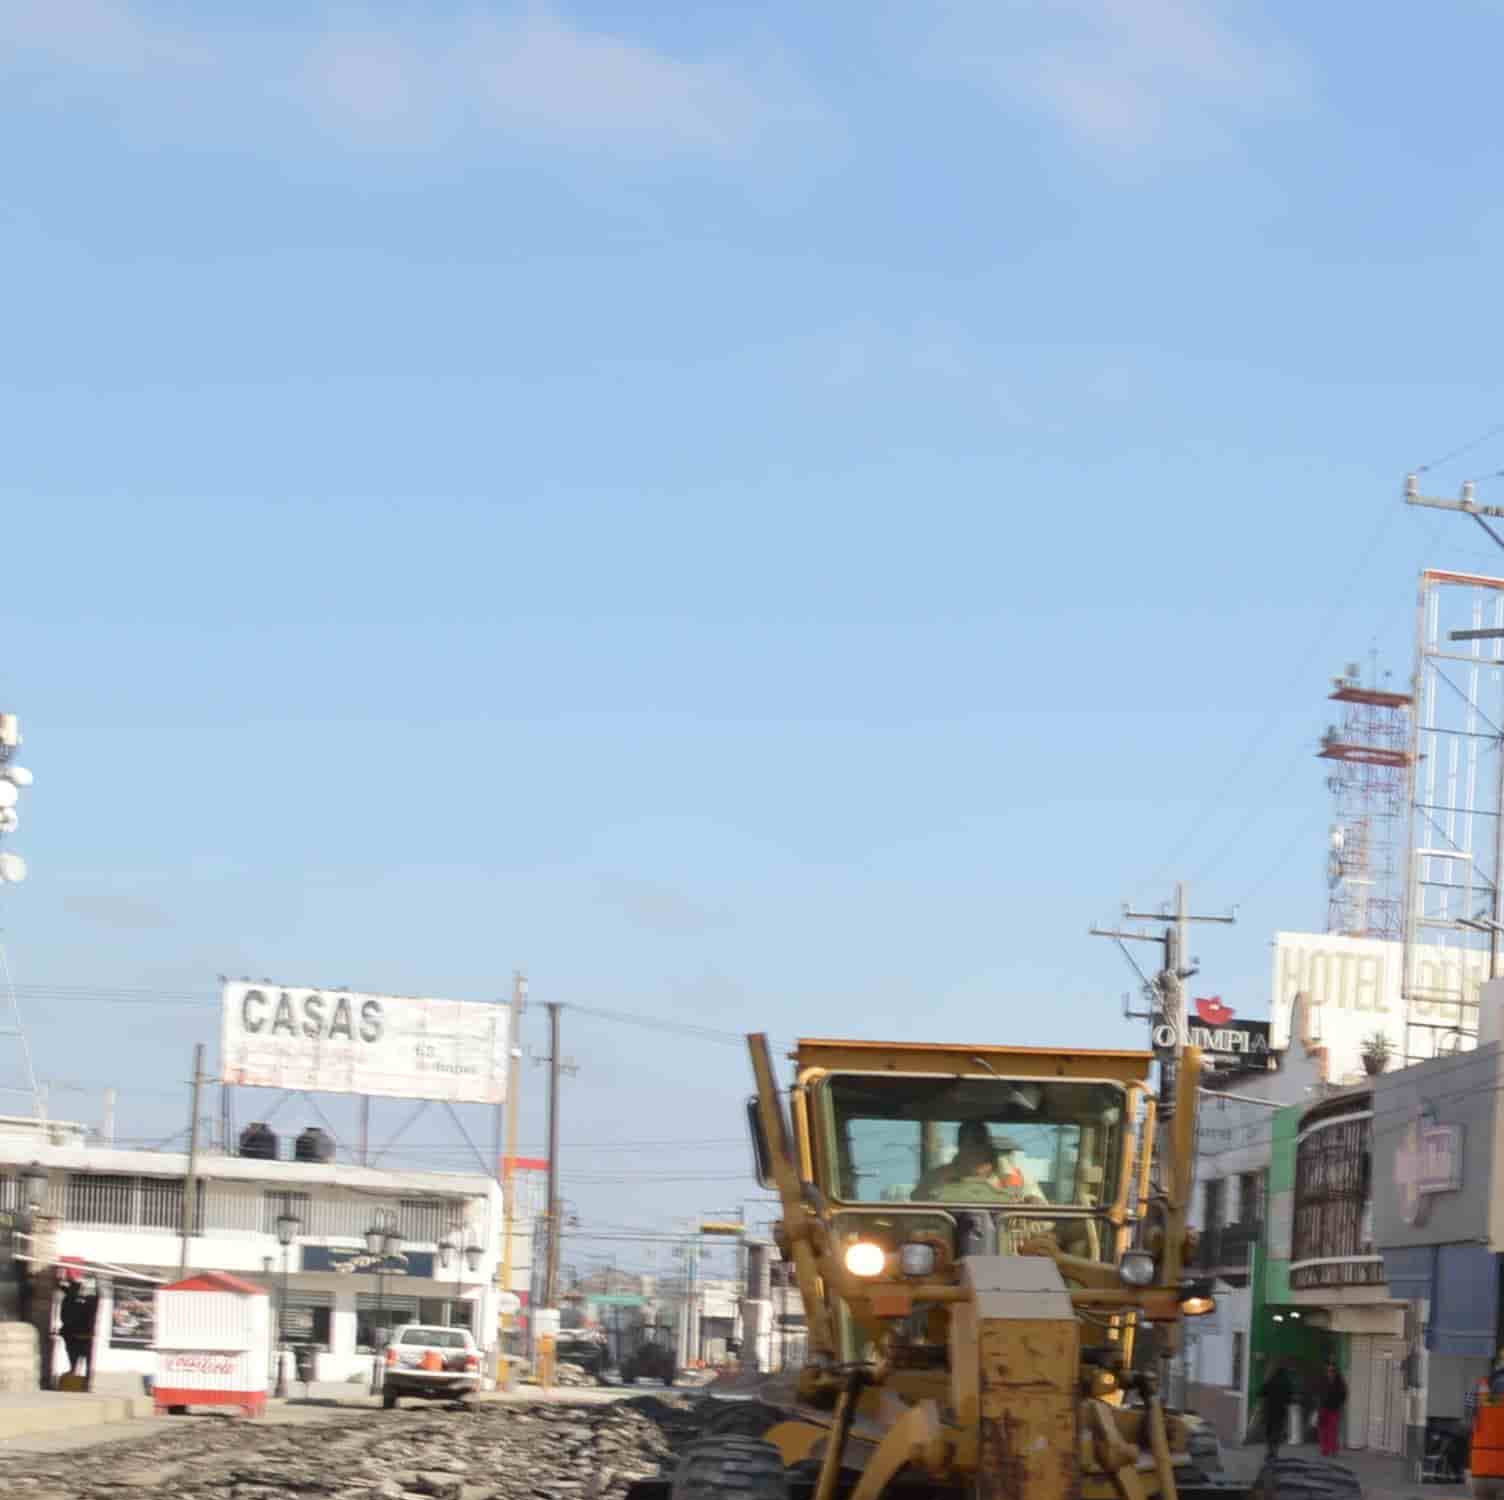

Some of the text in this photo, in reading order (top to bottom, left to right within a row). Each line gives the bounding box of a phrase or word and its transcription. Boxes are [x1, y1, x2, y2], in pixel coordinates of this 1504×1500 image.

[1280, 945, 1391, 1014] HOTEL
[242, 989, 385, 1042] CASAS
[1152, 1024, 1268, 1054] OIMPIA
